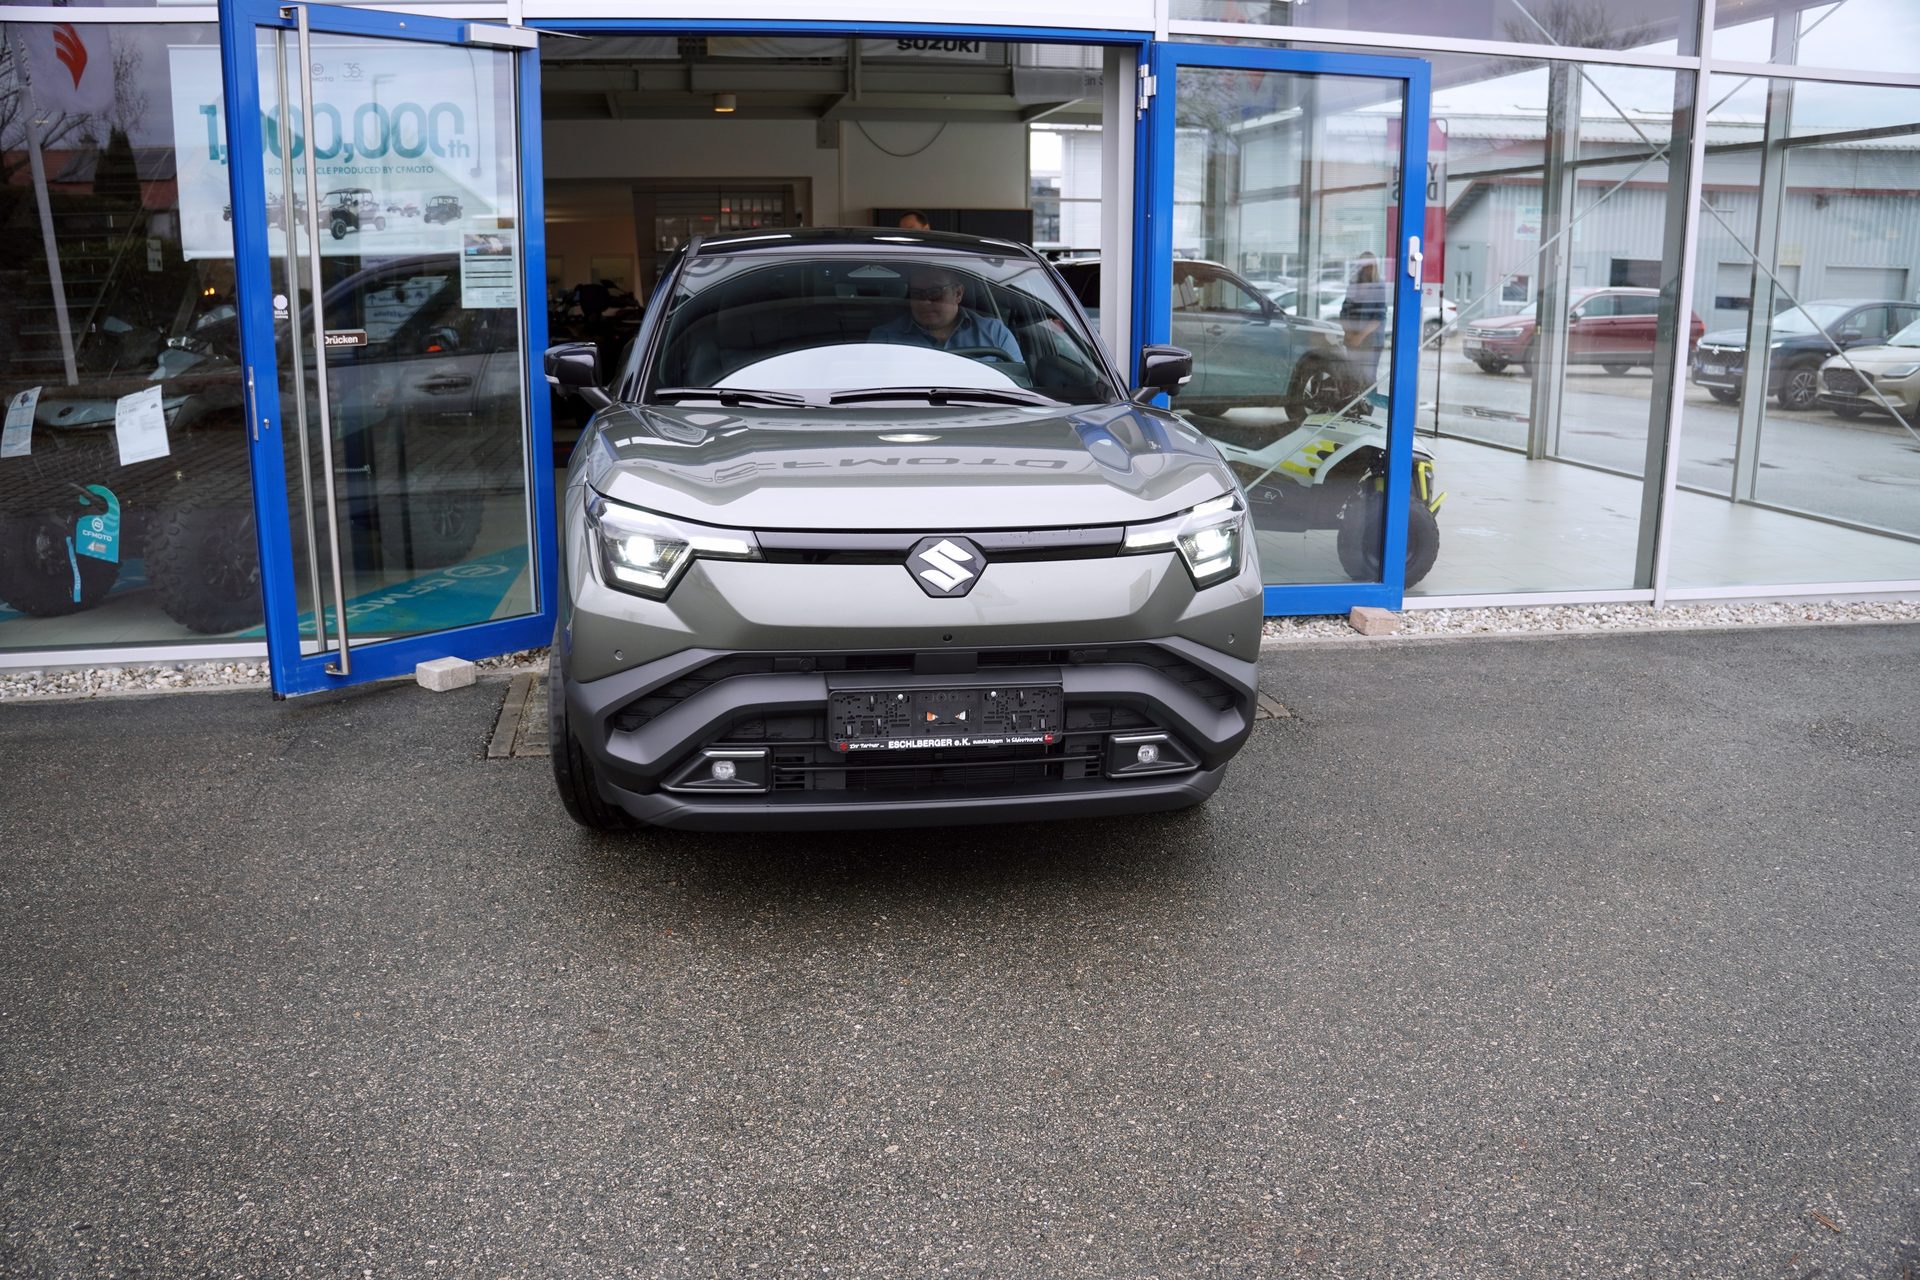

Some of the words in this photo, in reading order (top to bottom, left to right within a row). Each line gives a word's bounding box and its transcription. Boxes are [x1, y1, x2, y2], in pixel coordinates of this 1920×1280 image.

[897, 40, 980, 53] SUZUKI
[296, 166, 332, 175] VCLE
[333, 166, 381, 175] PRODUCED
[383, 165, 393, 174] BY
[395, 165, 434, 174] CFMOTO
[82, 529, 113, 542] CFMOTO
[888, 738, 953, 749] ESCHLBERGER
[954, 738, 971, 746] e.K.
